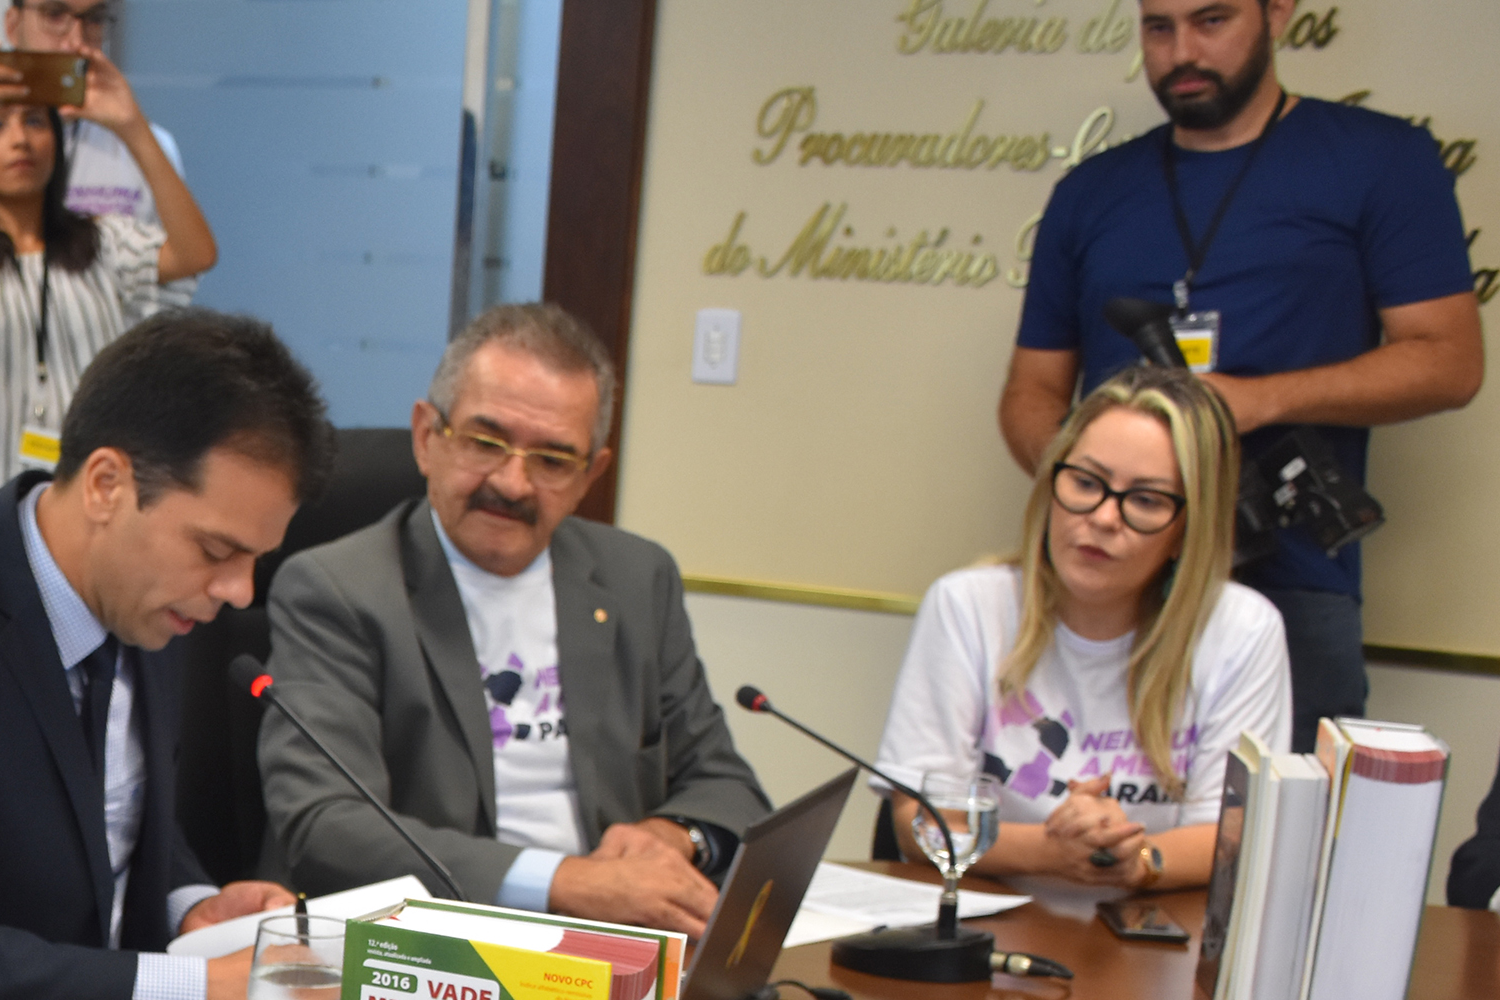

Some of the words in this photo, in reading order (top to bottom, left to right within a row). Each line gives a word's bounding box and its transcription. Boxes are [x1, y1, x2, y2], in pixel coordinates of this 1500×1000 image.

[703, 209, 752, 277] do
[755, 199, 999, 288] Ministério
[371, 971, 411, 990] 2016
[543, 972, 573, 986] NOVO
[574, 977, 593, 989] CPC
